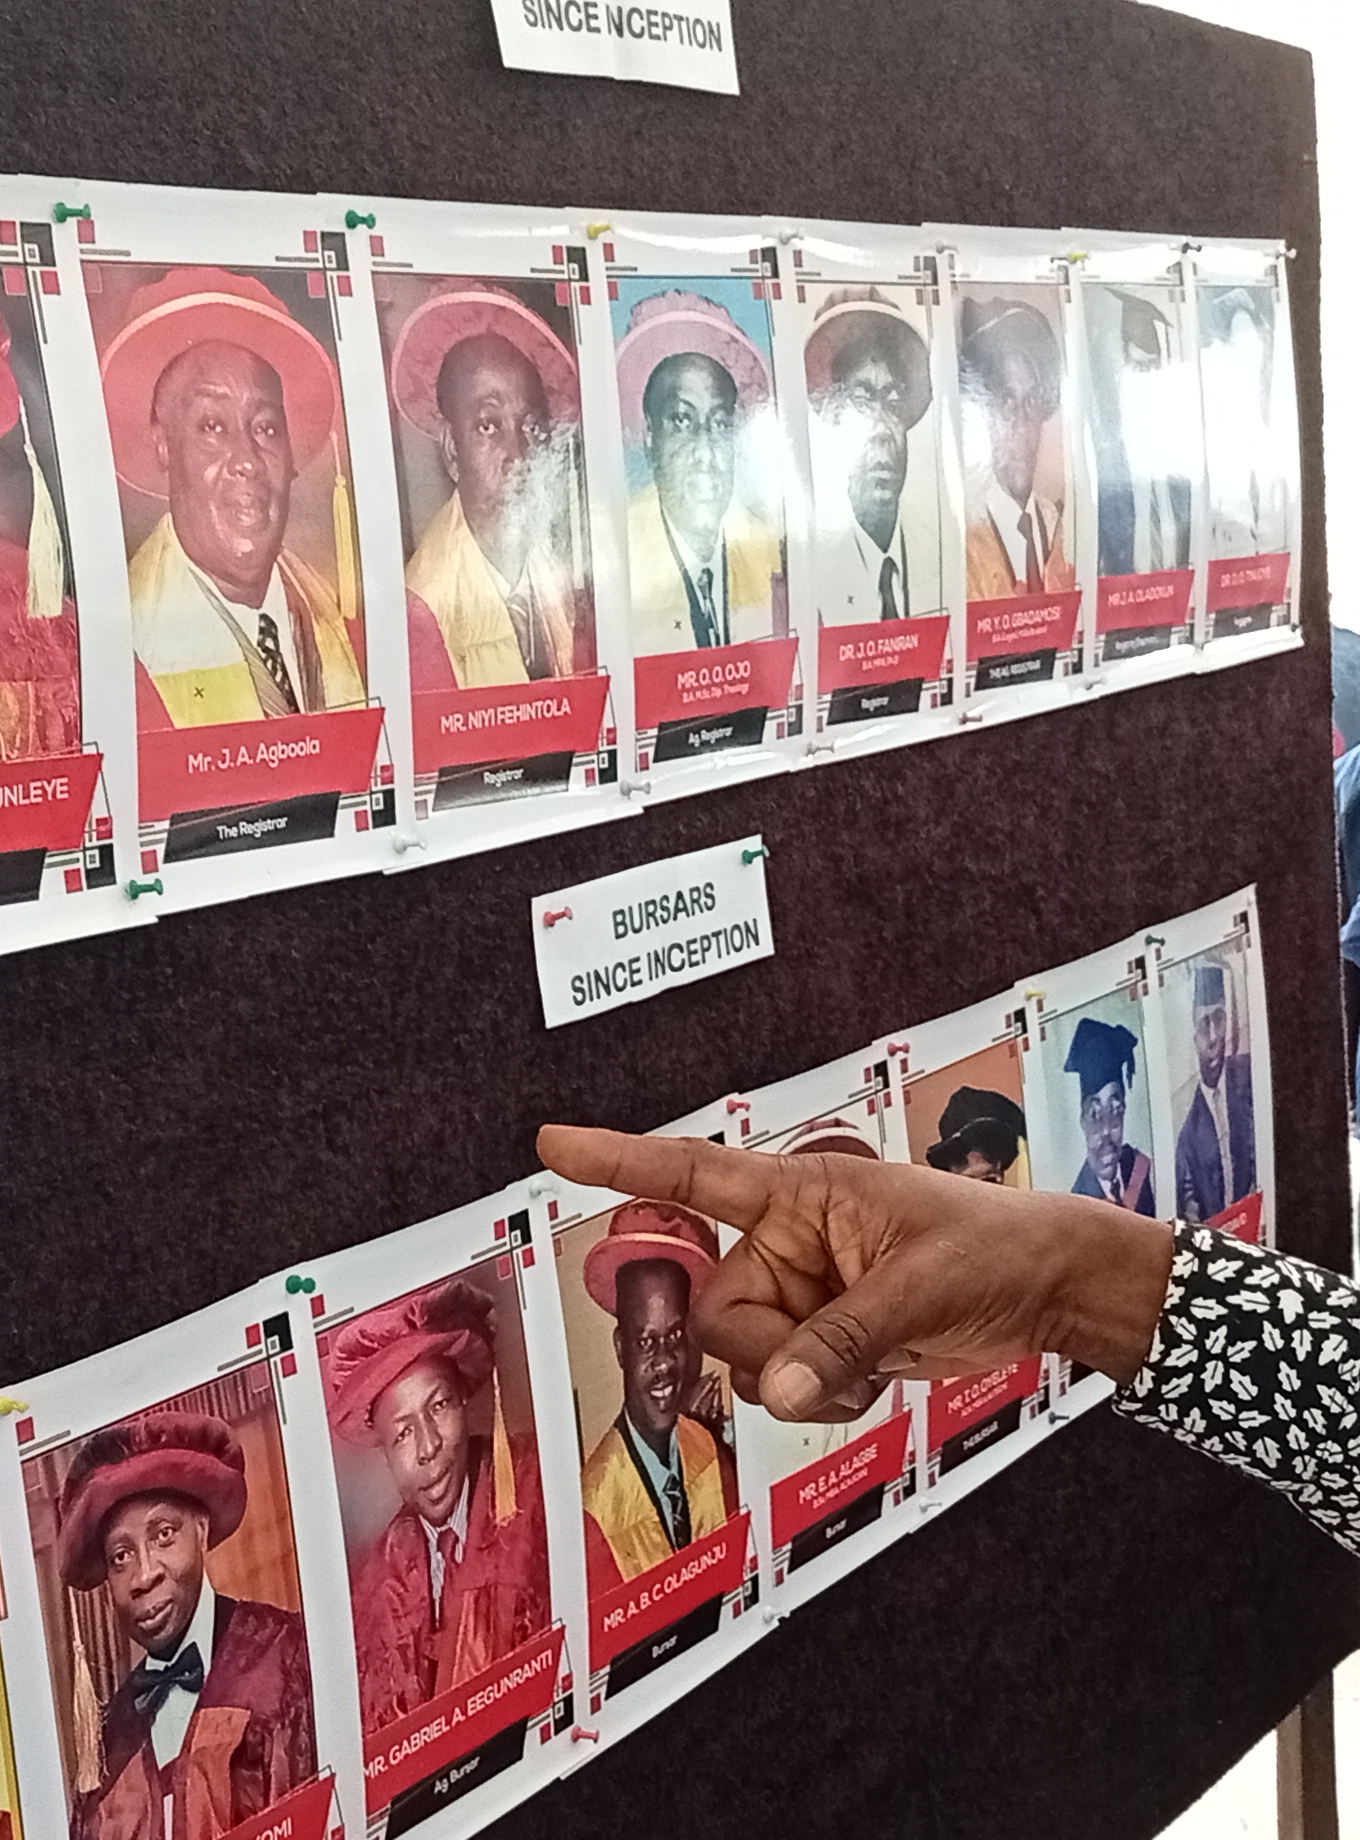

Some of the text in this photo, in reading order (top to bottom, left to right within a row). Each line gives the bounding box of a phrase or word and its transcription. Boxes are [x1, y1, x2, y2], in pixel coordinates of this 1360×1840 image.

[521, 0, 601, 34] SINCE
[725, 660, 751, 681] OJO
[440, 697, 572, 735] MR. NIYI FEHINTOLA
[188, 736, 320, 774] Mr. J. A. Agboola
[483, 767, 524, 788] Registrar
[216, 815, 288, 841] The Registrar
[612, 881, 716, 940] BURSARS
[570, 918, 760, 1006] SINCE INCEPTION
[663, 1541, 727, 1594] OLAGUNJU
[652, 1635, 678, 1659] Bursar
[363, 1648, 553, 1780] MR. GABRIEL A. EEGUNRANTI
[433, 1755, 481, 1795] Ag Bursar
